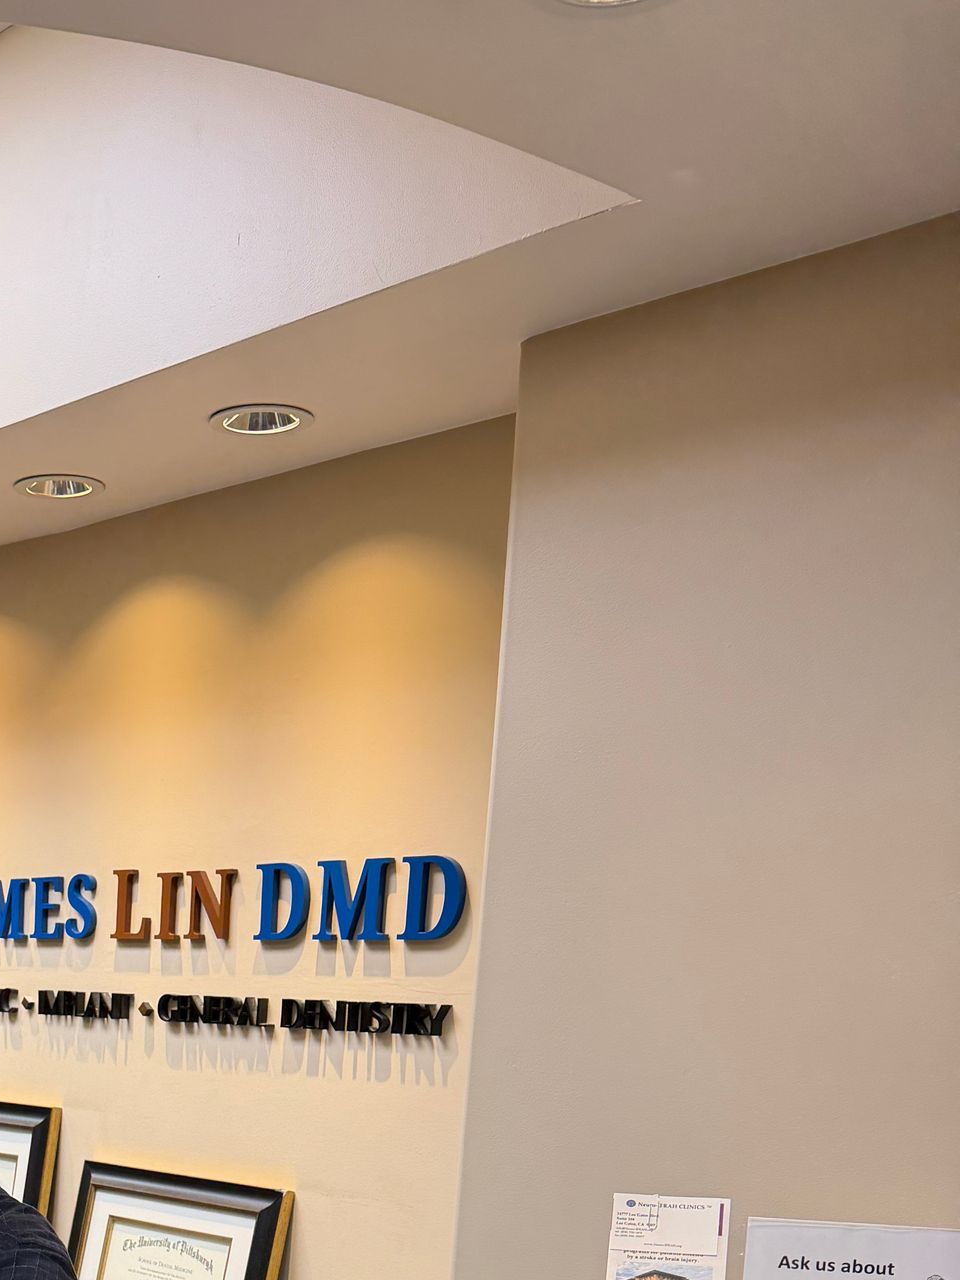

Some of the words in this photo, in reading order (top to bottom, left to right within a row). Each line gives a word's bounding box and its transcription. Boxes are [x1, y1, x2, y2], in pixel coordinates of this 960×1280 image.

[110, 869, 238, 940] LIN
[253, 855, 467, 941] DMD
[158, 994, 275, 1028] GENERAL
[280, 998, 453, 1036] DENTISTRY
[778, 1256, 810, 1270] Ask
[816, 1259, 836, 1272] us
[841, 1259, 895, 1276] about
